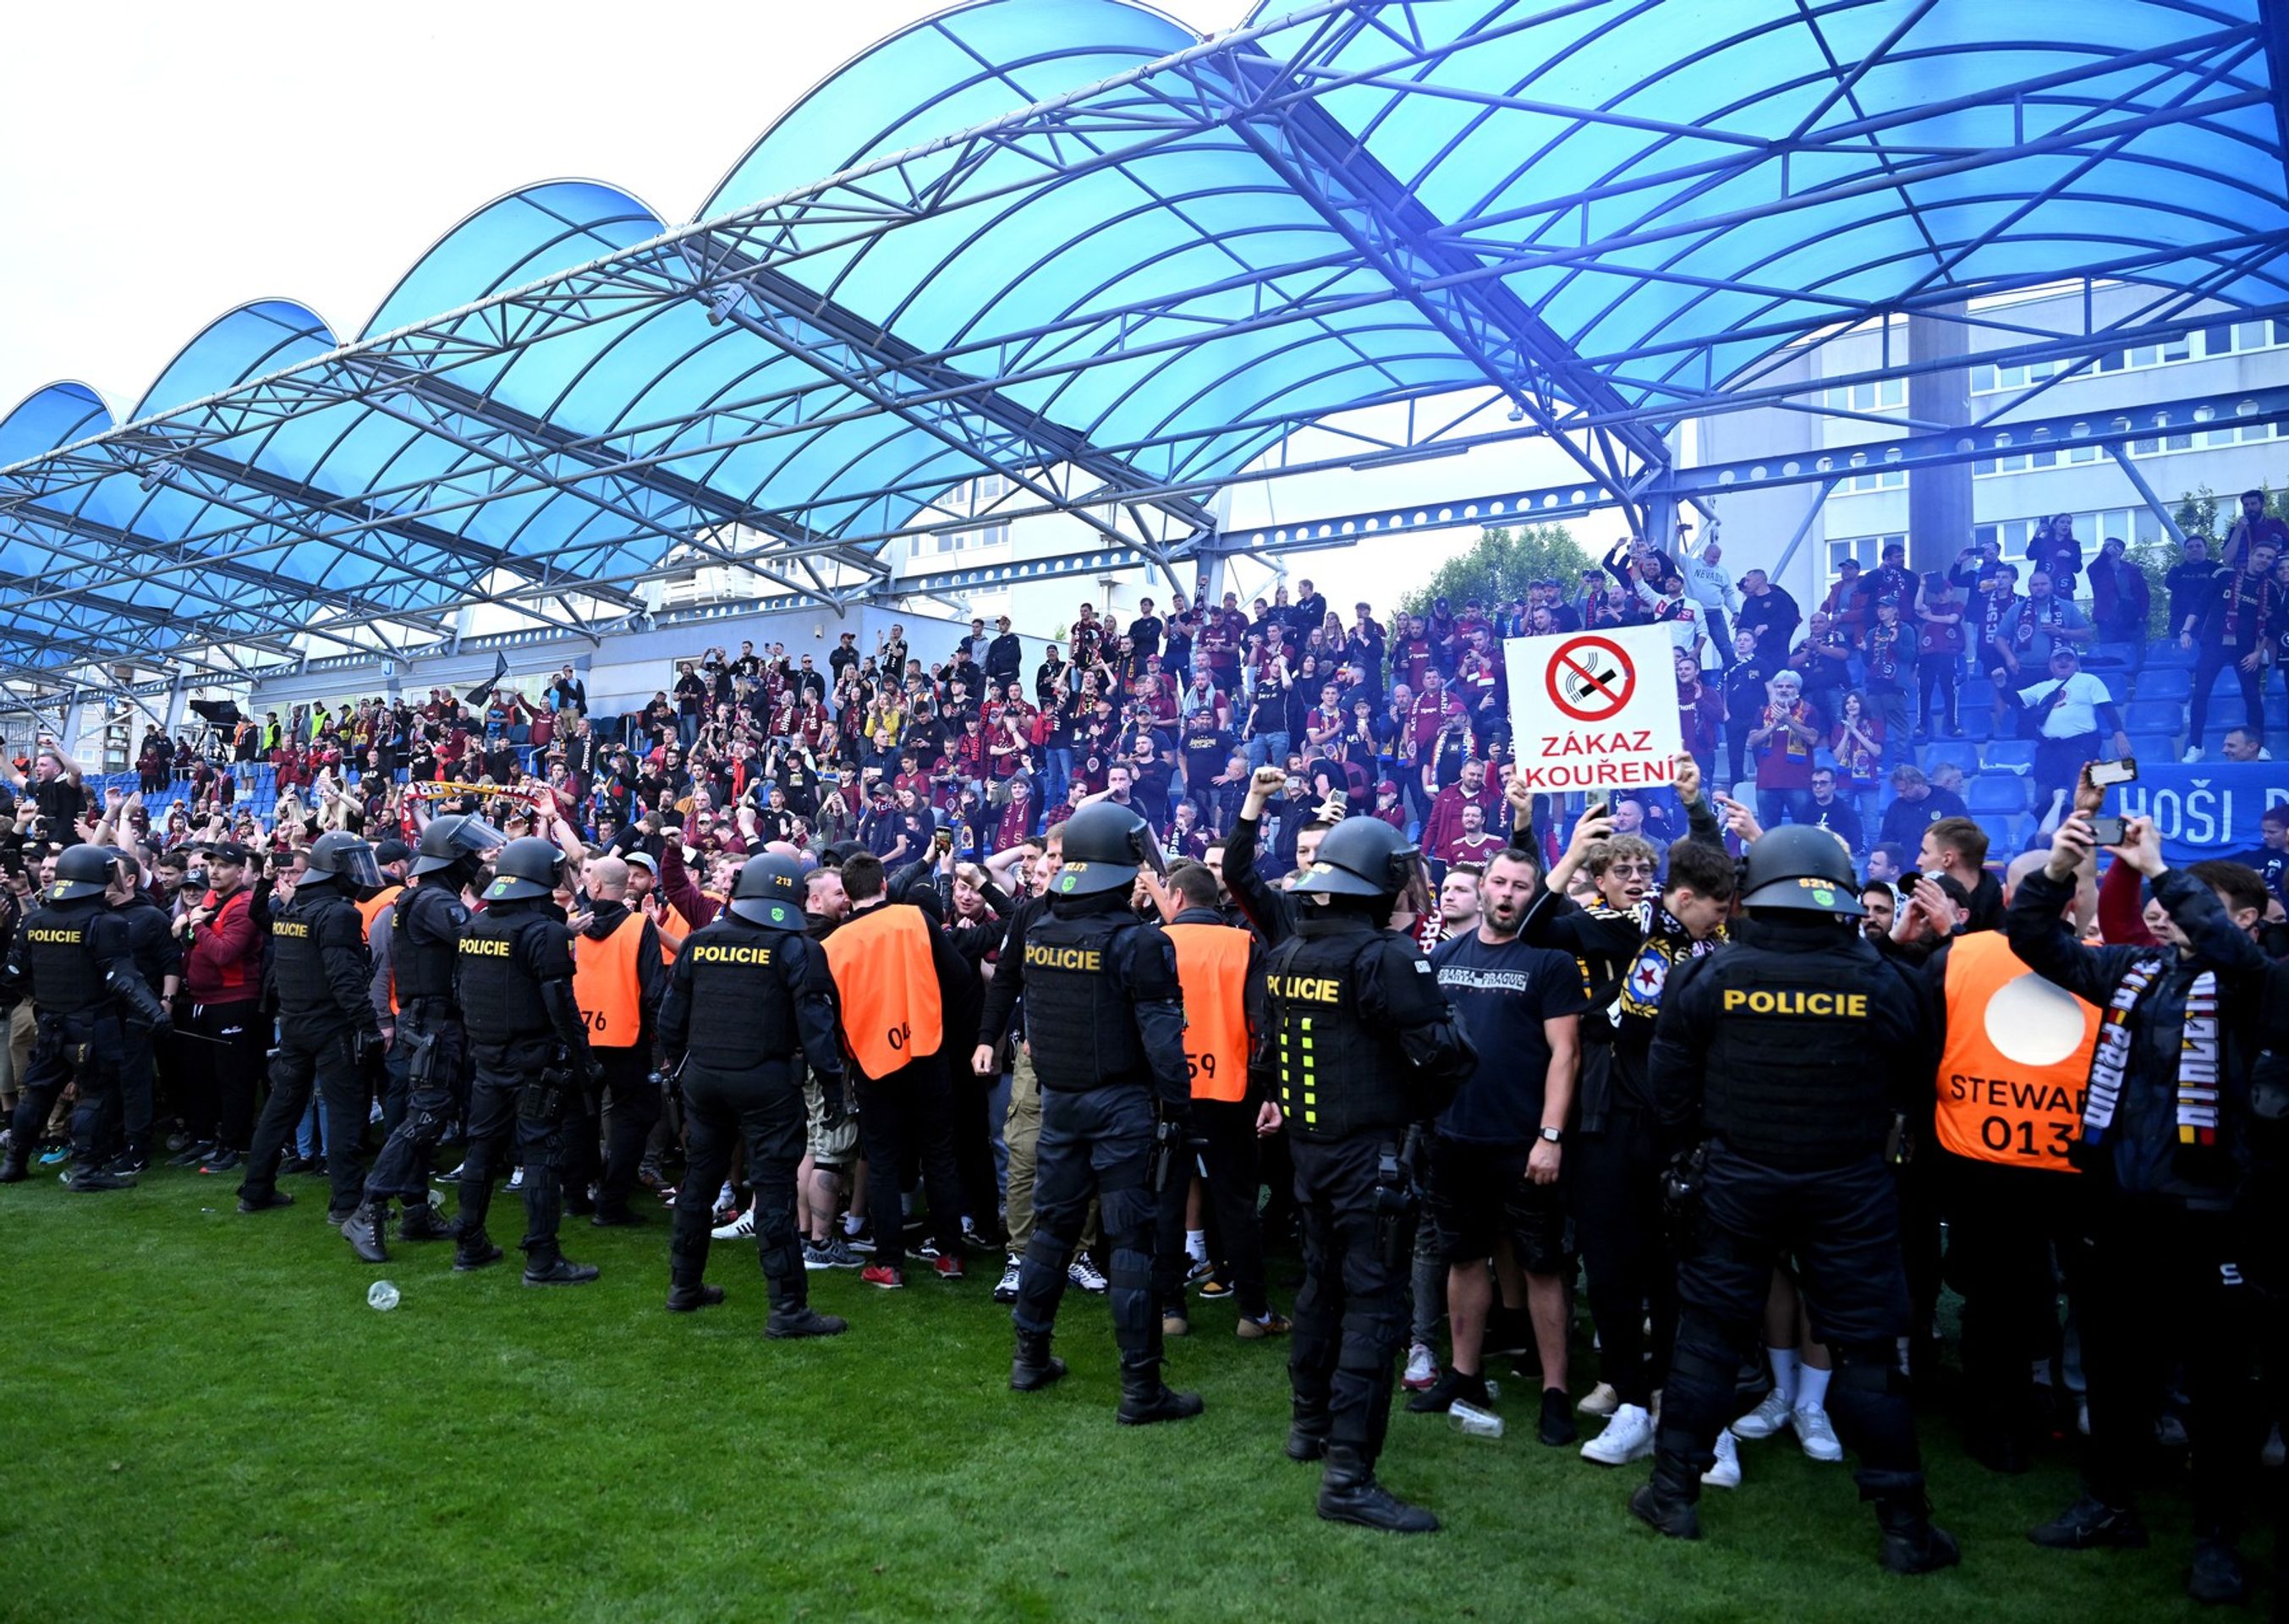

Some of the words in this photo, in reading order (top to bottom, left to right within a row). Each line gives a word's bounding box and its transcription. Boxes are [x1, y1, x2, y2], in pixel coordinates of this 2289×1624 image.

[384, 664, 392, 675] J
[106, 695, 117, 706] K
[1541, 730, 1653, 757] ZÁKAZ
[1525, 754, 1675, 787] KOUŘENÍ
[2119, 779, 2232, 843] HOŠI
[776, 875, 793, 887] 213
[28, 930, 82, 942] POLICIE
[272, 922, 308, 938] POLICIE
[459, 938, 510, 957] POLICIE
[693, 946, 771, 964] POLICIE
[1025, 945, 1100, 969] POLICIE
[1438, 968, 1475, 983] SPARTA
[1483, 973, 1526, 989] PRAGUE
[1724, 989, 1868, 1017] POLICIE
[581, 1011, 607, 1031] 76
[1186, 1053, 1216, 1079] 59
[1982, 1116, 2074, 1158] 013
